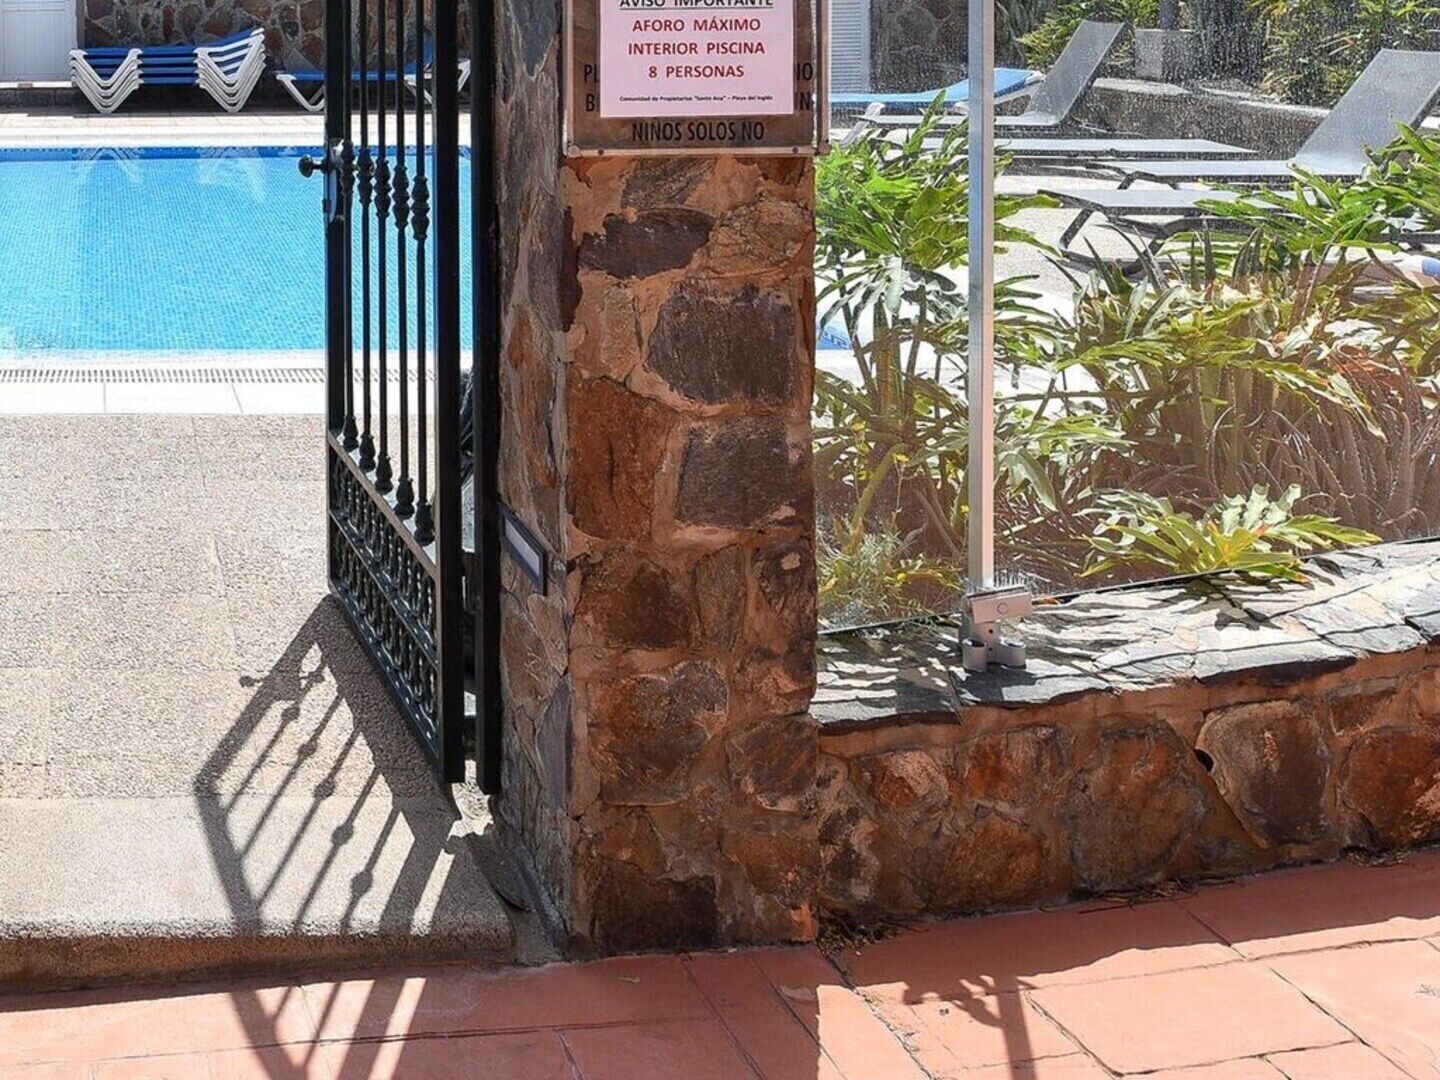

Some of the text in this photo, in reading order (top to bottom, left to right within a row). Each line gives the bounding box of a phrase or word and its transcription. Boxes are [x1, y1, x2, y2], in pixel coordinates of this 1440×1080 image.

[632, 16, 761, 32] AFORO MÁXIMO
[628, 42, 766, 55] INTERIOR PISCINA
[648, 65, 744, 78] 8 PERSONAS
[687, 121, 736, 141] SOLOS
[741, 121, 765, 141] NO
